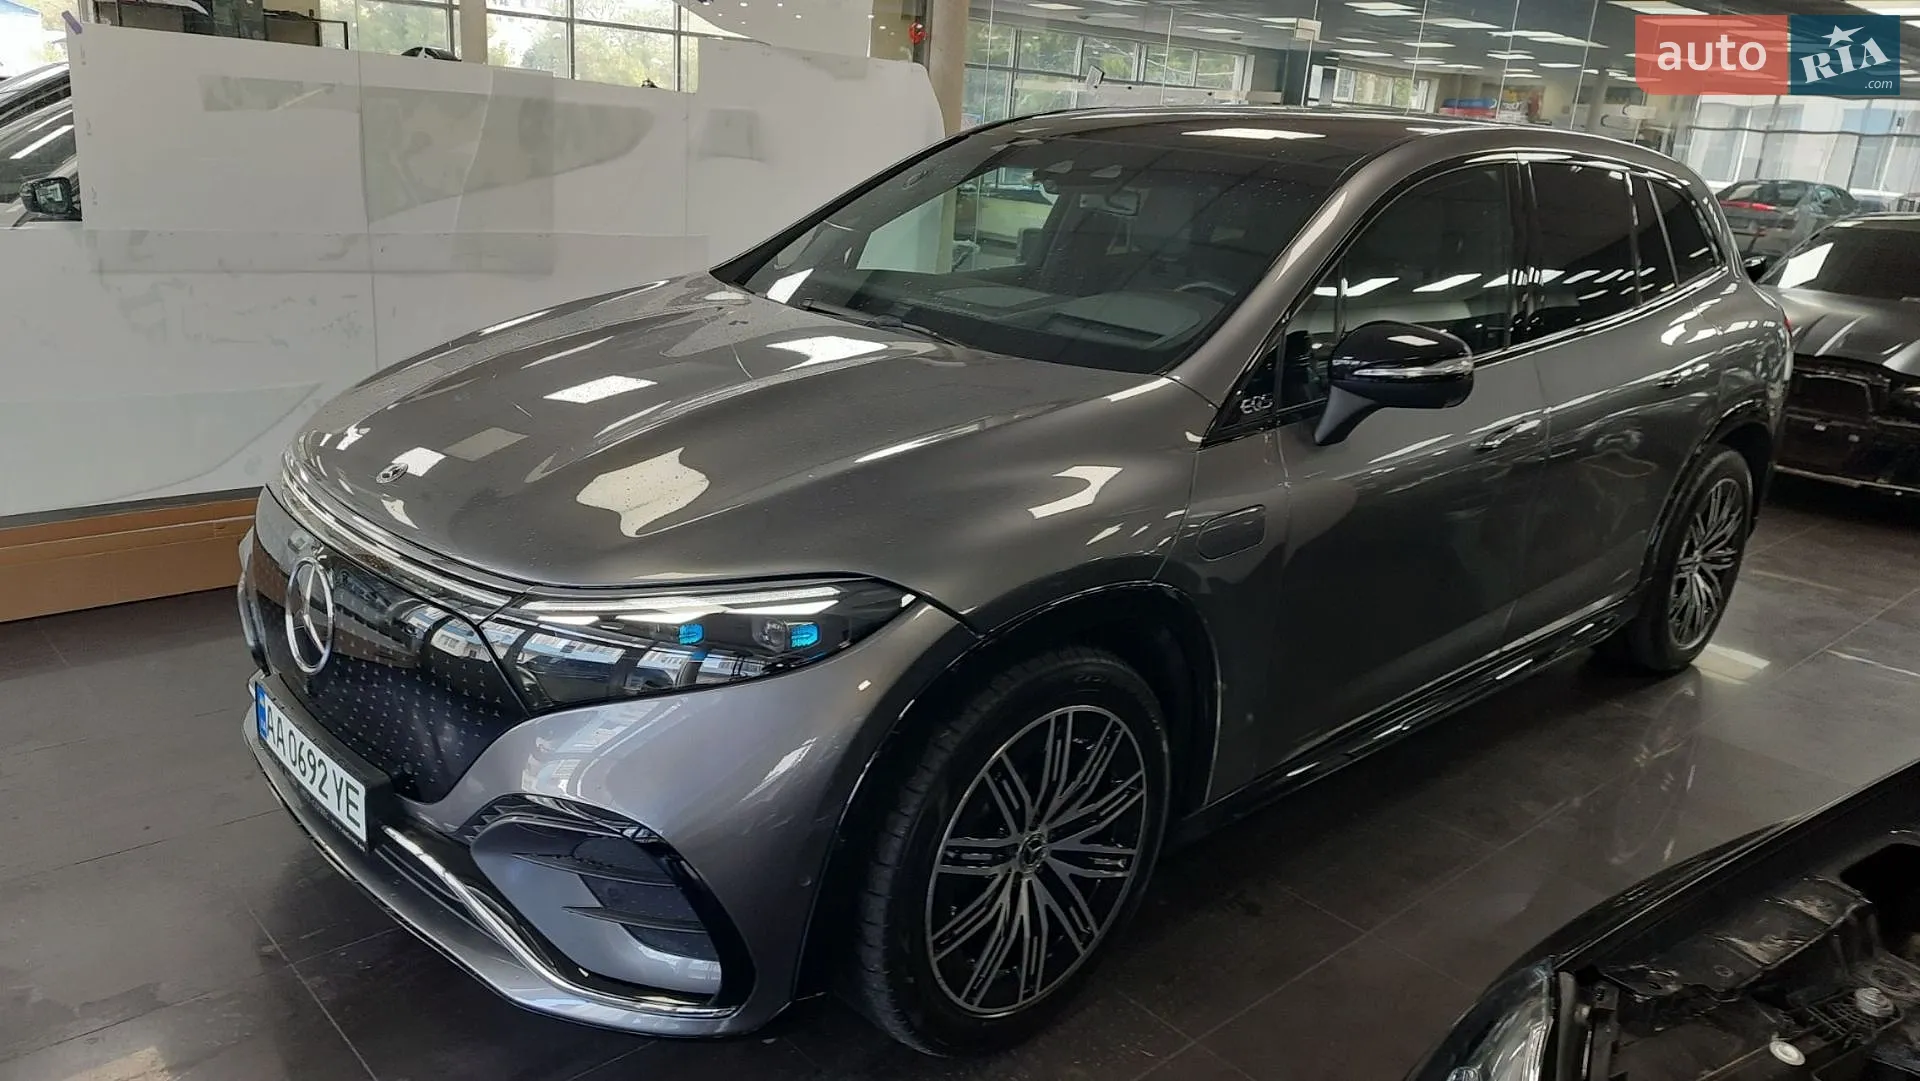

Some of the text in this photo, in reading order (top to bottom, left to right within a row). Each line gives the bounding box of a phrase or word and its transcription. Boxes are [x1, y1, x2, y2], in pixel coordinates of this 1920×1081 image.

[267, 706, 286, 757] AA
[288, 729, 329, 800] 0692
[332, 768, 361, 829] YE
